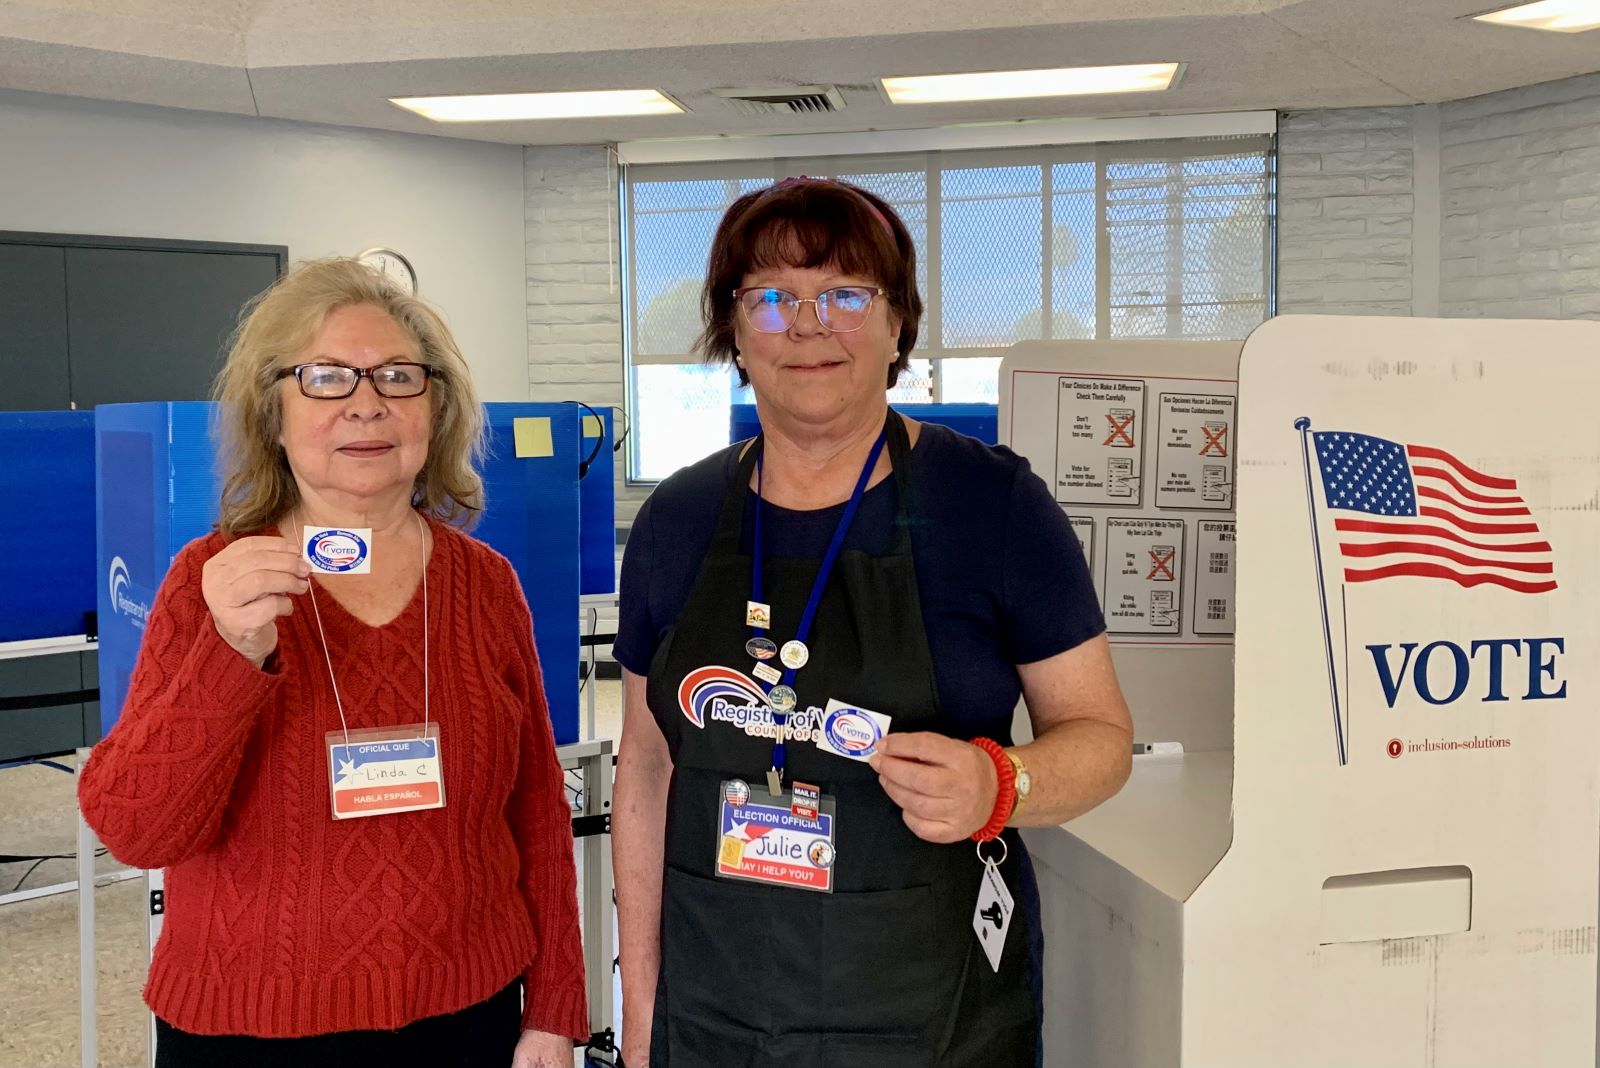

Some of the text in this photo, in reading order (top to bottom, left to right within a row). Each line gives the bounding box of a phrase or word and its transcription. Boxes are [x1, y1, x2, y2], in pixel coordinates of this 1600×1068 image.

[1074, 382, 1091, 390] Choices
[1106, 394, 1126, 403] Carefully
[1365, 637, 1567, 708] VOTE
[714, 701, 793, 725] Registr
[795, 709, 815, 727] of
[747, 725, 793, 737] COUNY
[796, 730, 810, 739] OF
[846, 727, 870, 740] VOTED
[359, 742, 410, 754] OFICIAL QUE
[366, 763, 427, 780] Linda C
[354, 790, 422, 804] HABLA ESPAÑOL
[795, 788, 810, 798] MAIL
[794, 797, 810, 806] DROP
[734, 809, 823, 830] ELECTION OFFICIAL
[756, 836, 802, 859] Julie
[763, 865, 787, 875] HELP
[789, 869, 814, 880] YOU?
